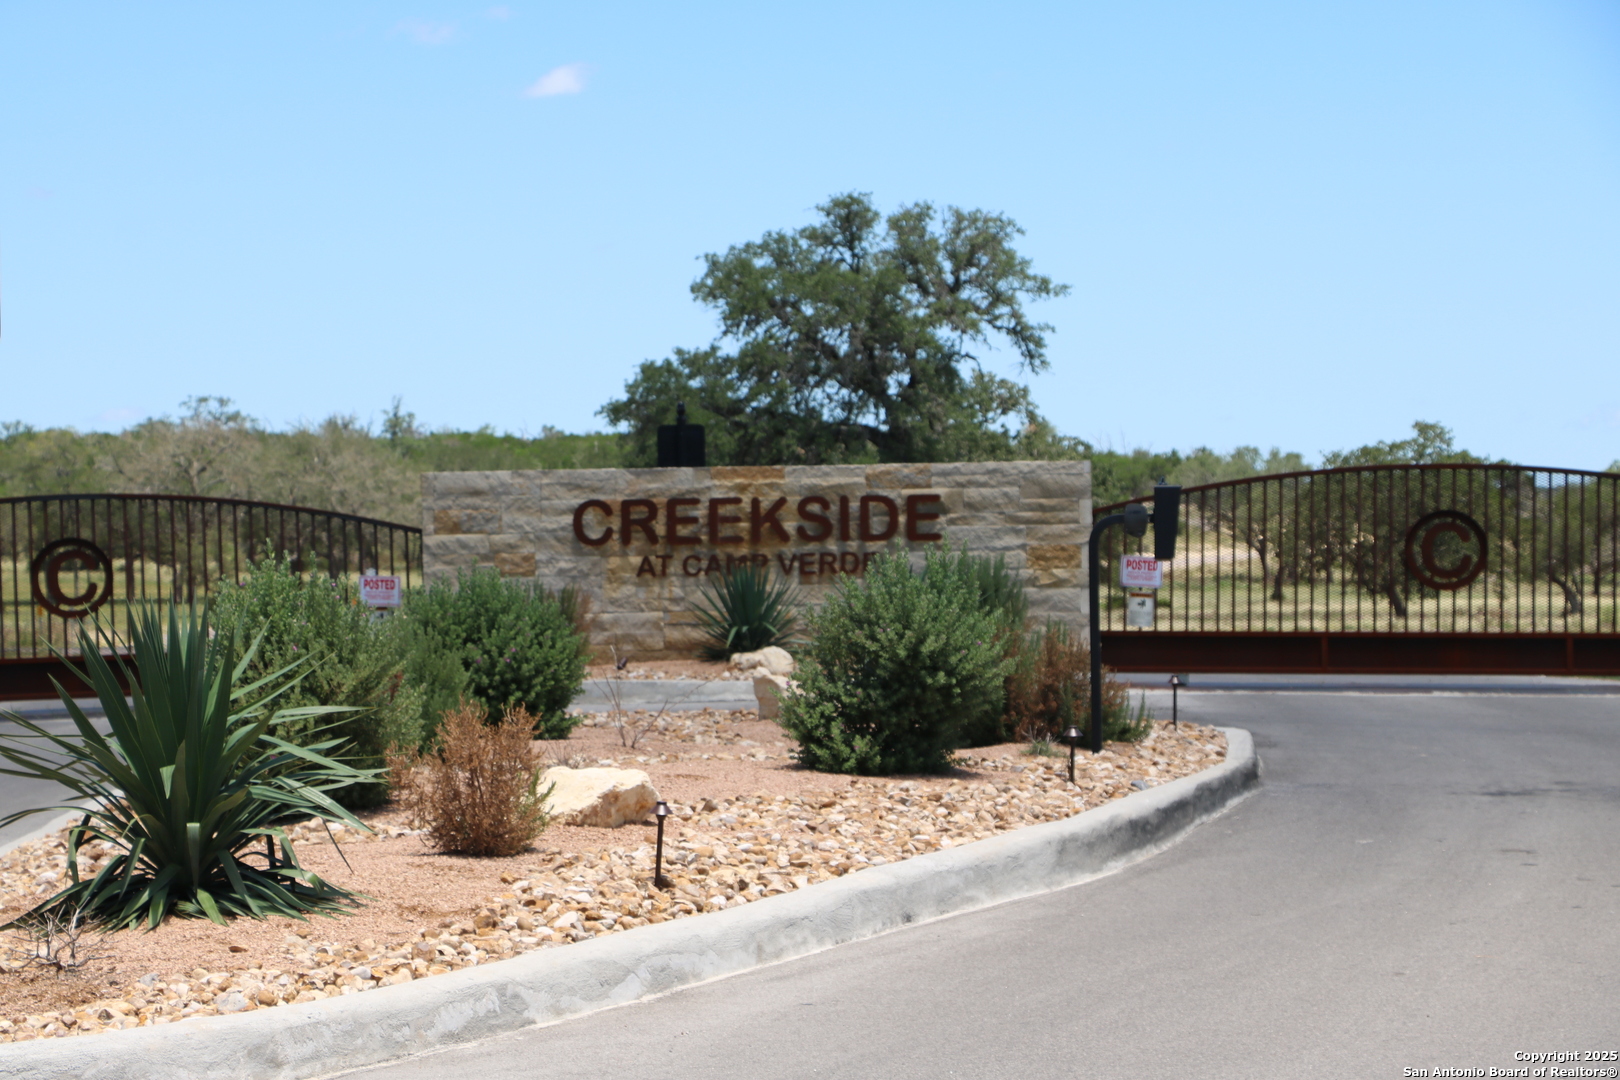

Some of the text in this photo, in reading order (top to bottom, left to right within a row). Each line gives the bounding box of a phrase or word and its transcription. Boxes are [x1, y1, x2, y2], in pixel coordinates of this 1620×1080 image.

[573, 494, 943, 547] CREEKSIDE
[636, 554, 673, 578] AT
[1126, 560, 1158, 571] POSTED
[364, 579, 395, 590] POSTED
